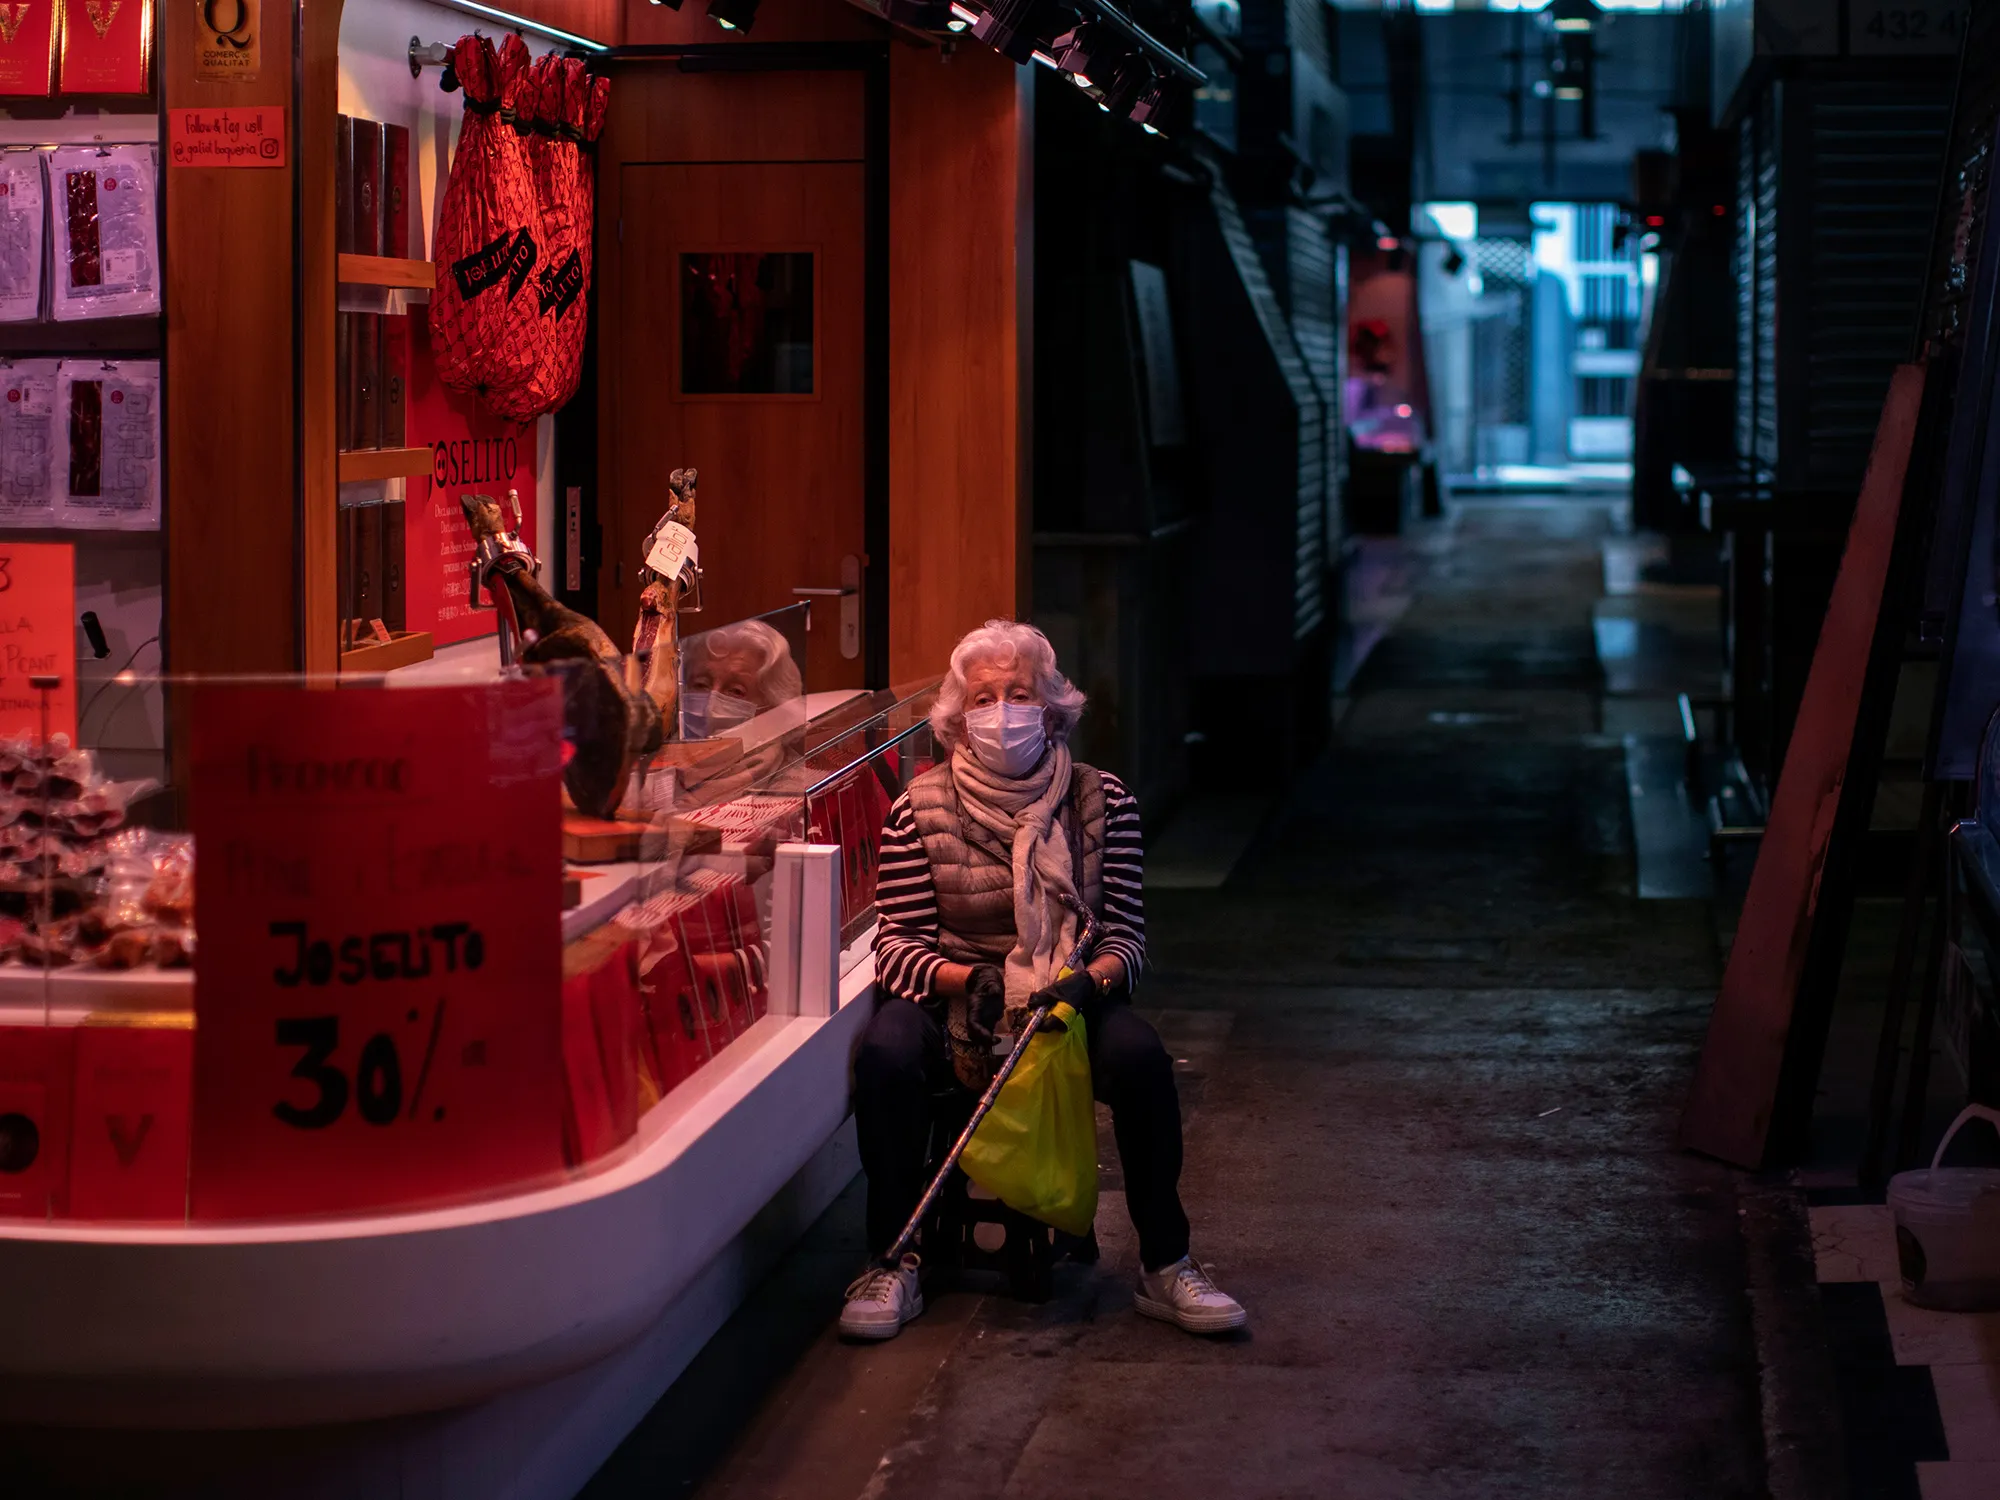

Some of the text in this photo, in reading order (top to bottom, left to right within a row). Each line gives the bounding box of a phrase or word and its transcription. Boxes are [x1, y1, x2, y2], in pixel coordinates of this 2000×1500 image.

[204, 0, 252, 48] Q
[1867, 9, 1928, 41] 432
[203, 59, 250, 67] QUALITAT
[222, 112, 239, 142] tag
[427, 437, 517, 502] JOSELITO
